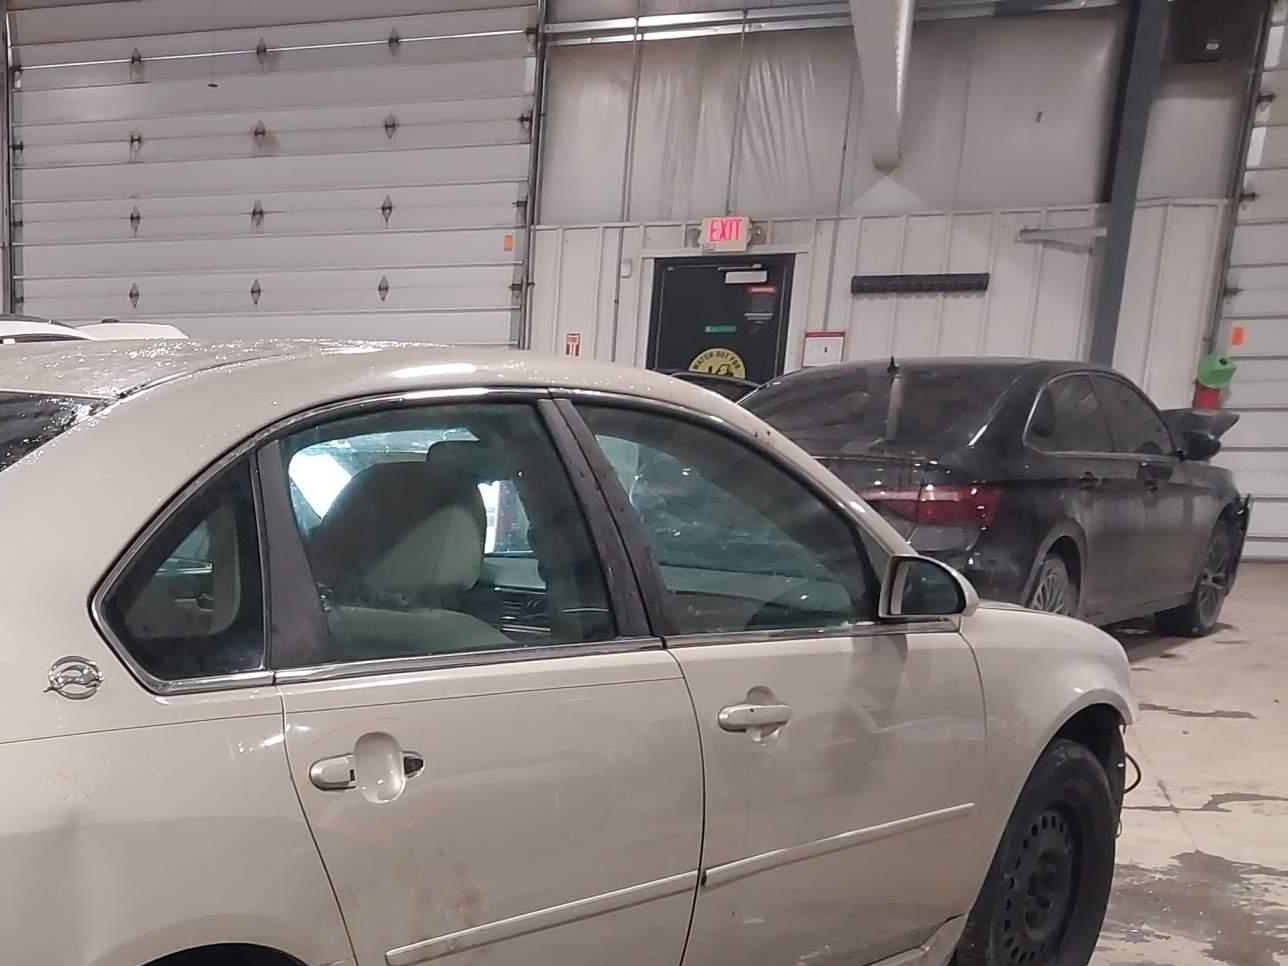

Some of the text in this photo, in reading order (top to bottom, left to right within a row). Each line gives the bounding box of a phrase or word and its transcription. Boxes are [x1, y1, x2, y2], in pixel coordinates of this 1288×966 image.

[710, 218, 742, 241] EXIT
[692, 350, 741, 370] WATCH OUT FOR
